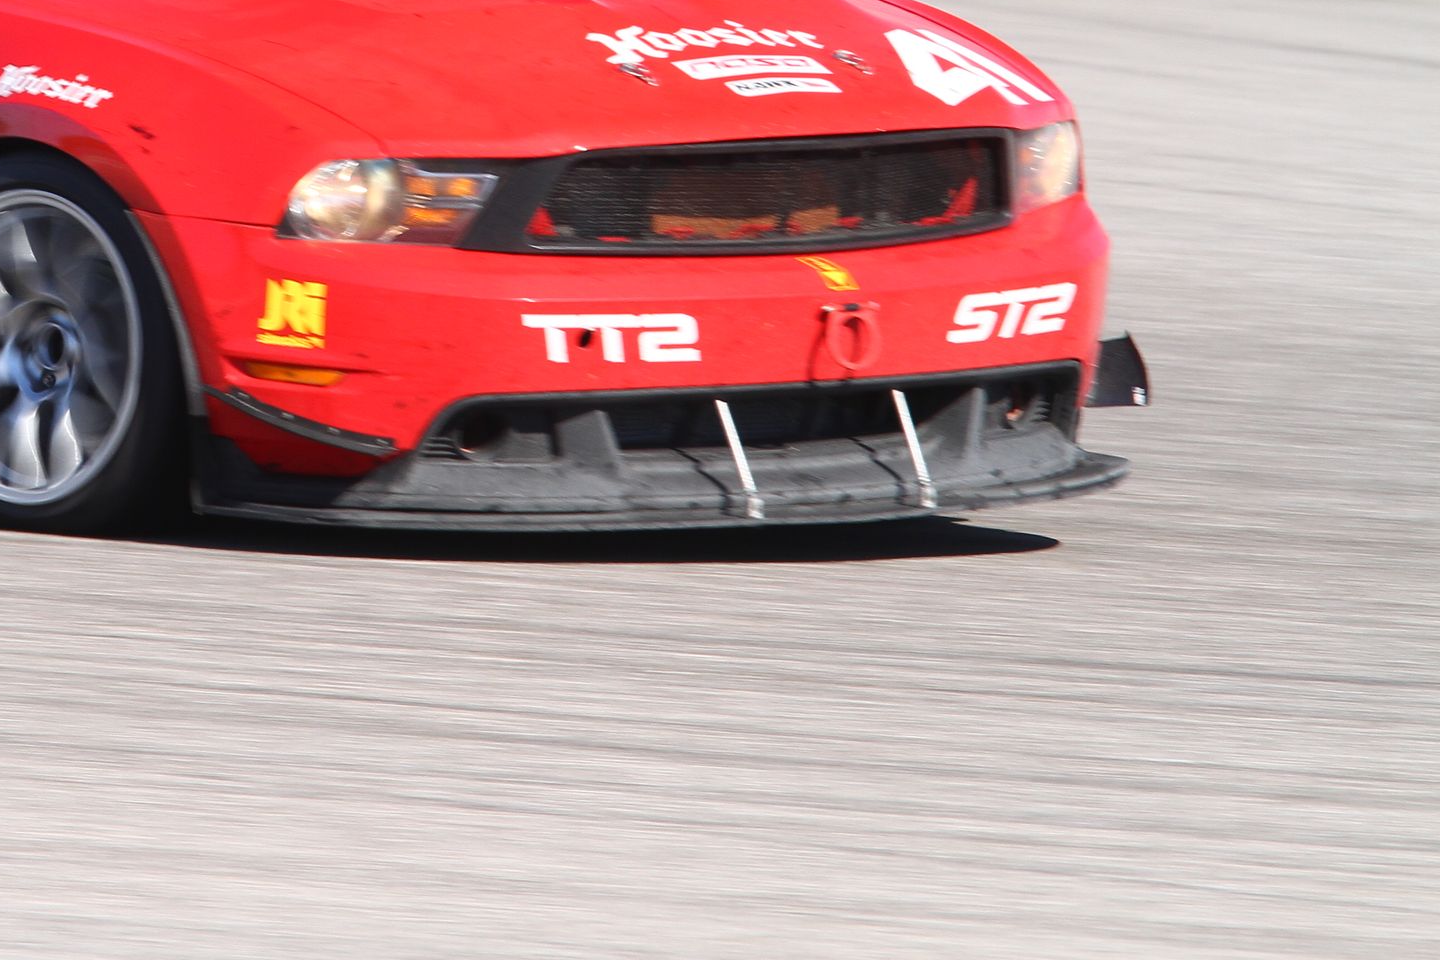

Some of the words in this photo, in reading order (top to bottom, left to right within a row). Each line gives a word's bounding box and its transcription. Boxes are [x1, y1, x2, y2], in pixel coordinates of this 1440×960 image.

[585, 19, 824, 64] Hoosier
[882, 28, 1055, 107] 41
[520, 313, 702, 363] TT2
[946, 282, 1077, 343] ST2
